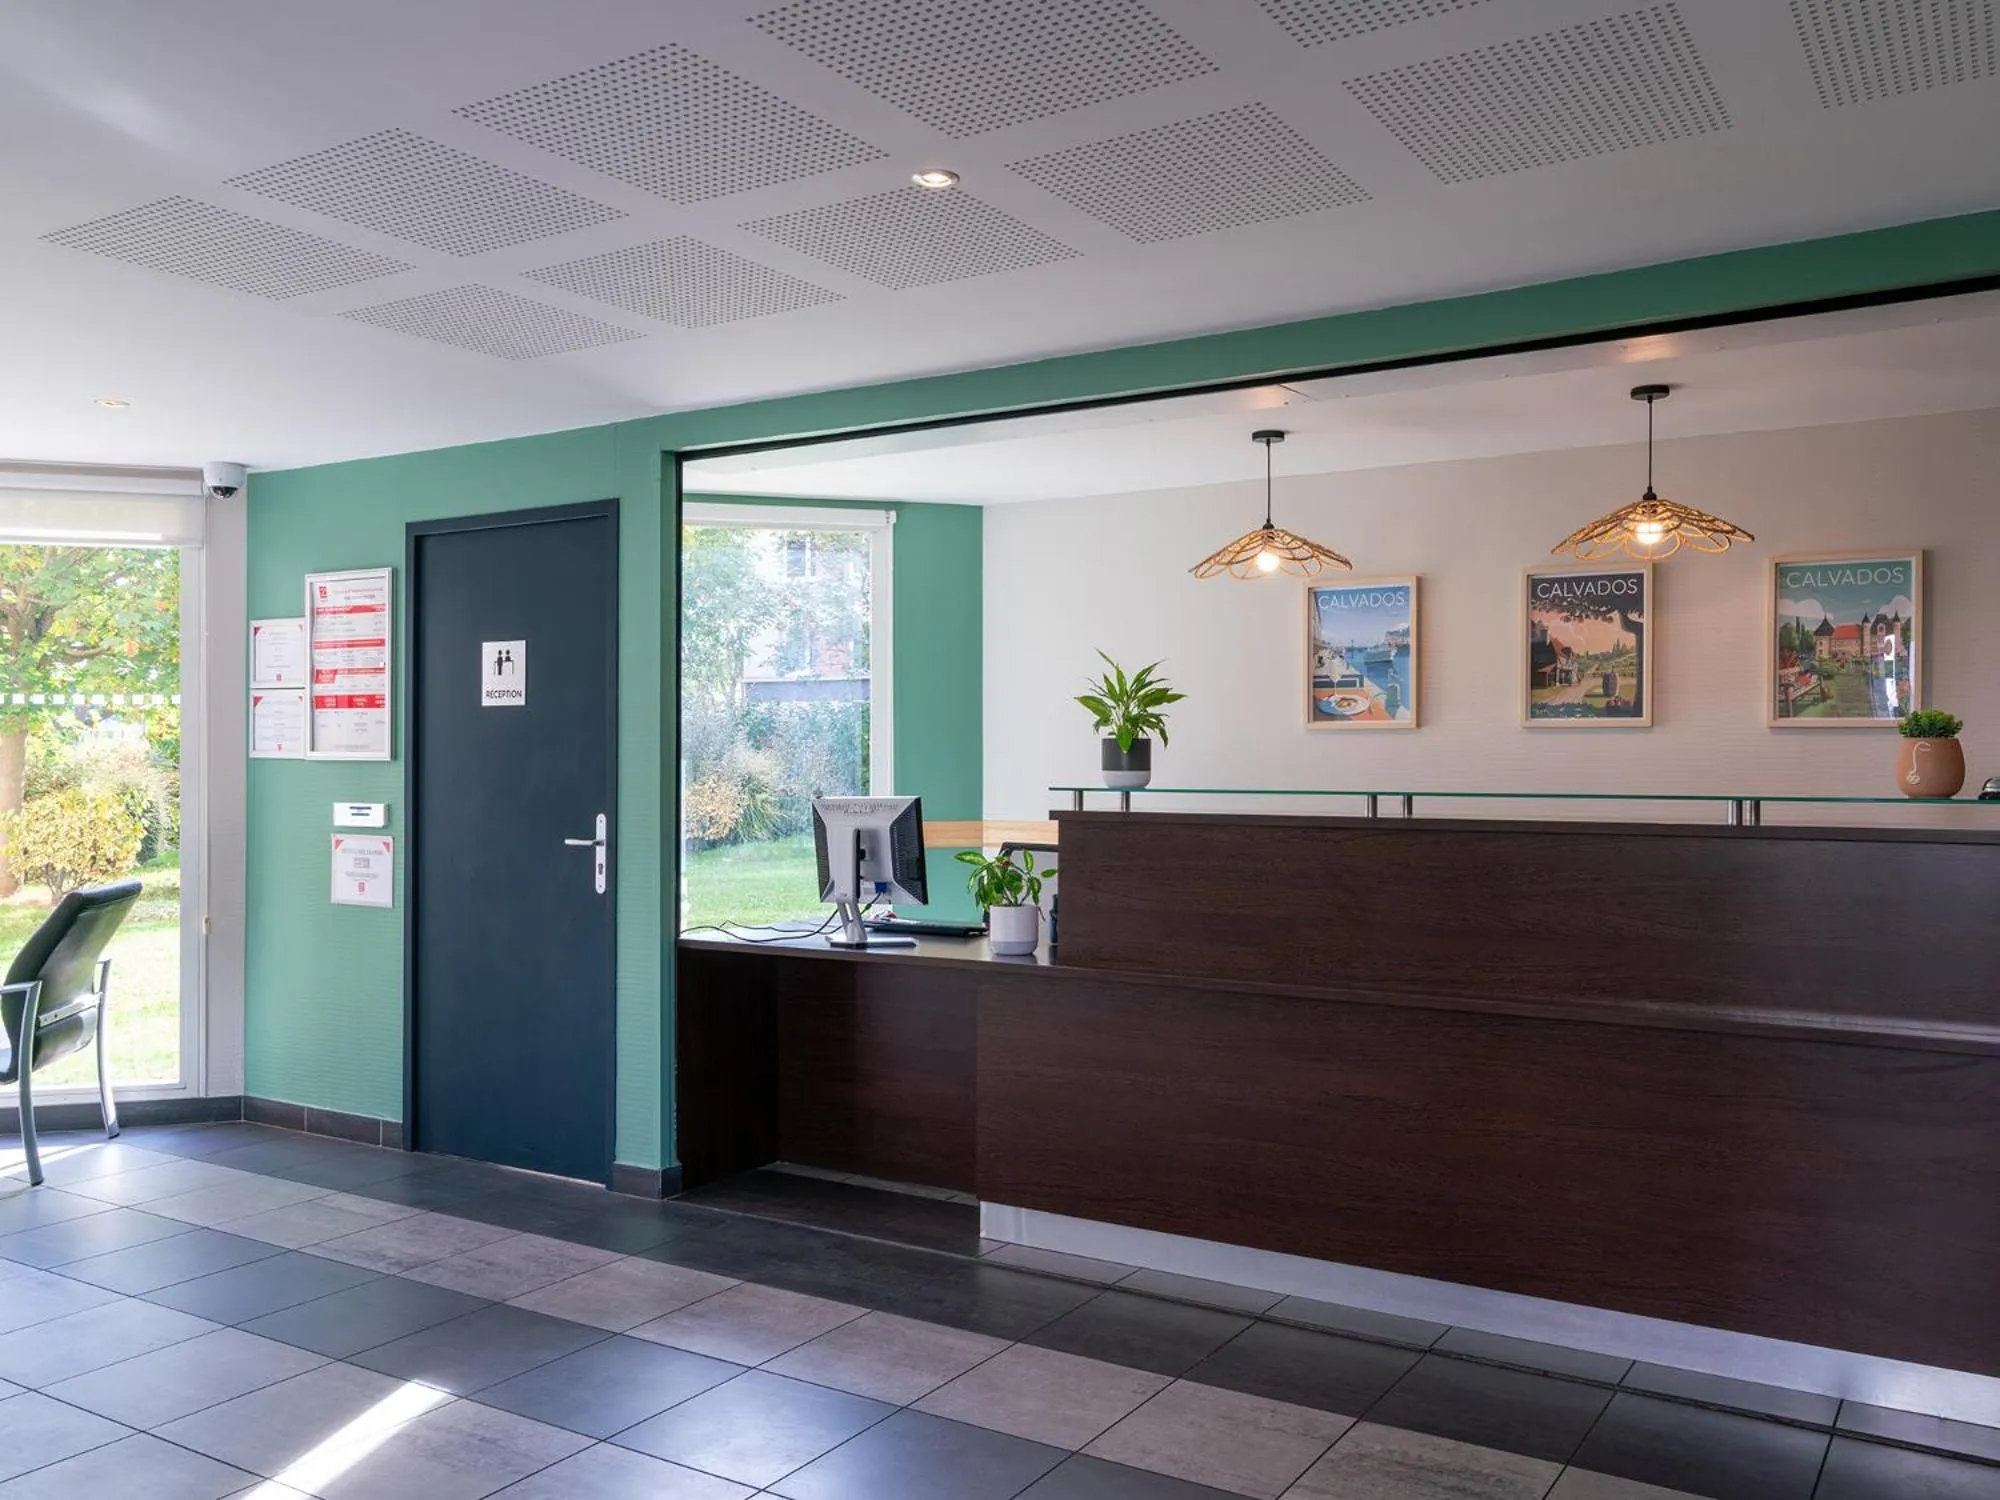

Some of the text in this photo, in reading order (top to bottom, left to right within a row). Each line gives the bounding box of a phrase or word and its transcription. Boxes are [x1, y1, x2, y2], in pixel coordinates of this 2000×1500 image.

[1786, 567, 1904, 588] CALVADOS
[1537, 578, 1638, 598] CALVADOS
[1318, 591, 1405, 610] CALVADOS
